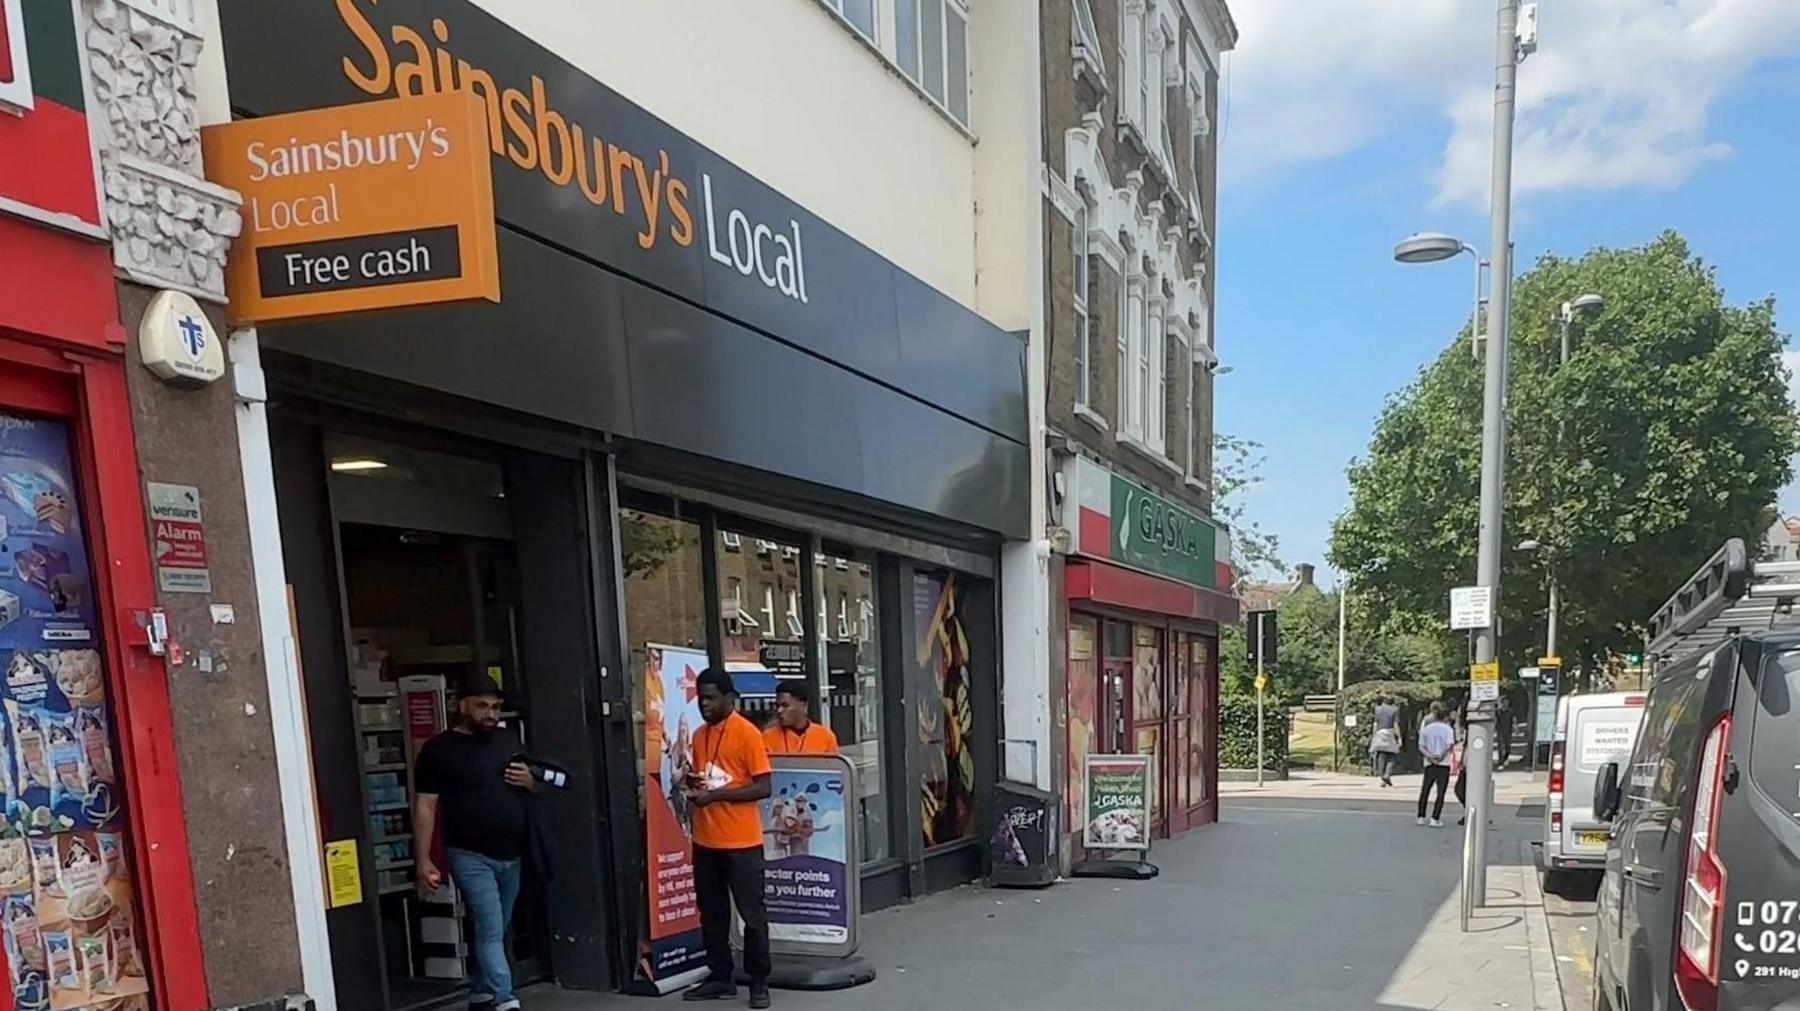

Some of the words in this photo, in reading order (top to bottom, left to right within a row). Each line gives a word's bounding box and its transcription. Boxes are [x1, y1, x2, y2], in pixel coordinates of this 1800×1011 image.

[247, 118, 450, 182] Sainsbury's
[336, 0, 693, 249] Sainsbury's
[703, 173, 808, 303] Local
[252, 183, 340, 233] Local
[284, 253, 350, 286] Free
[360, 238, 430, 278] cash
[157, 523, 202, 541] Alarm
[795, 869, 830, 882] points
[776, 885, 796, 896] you
[798, 885, 836, 898] further
[1761, 901, 1800, 925] 07
[1754, 966, 1775, 977] 291
